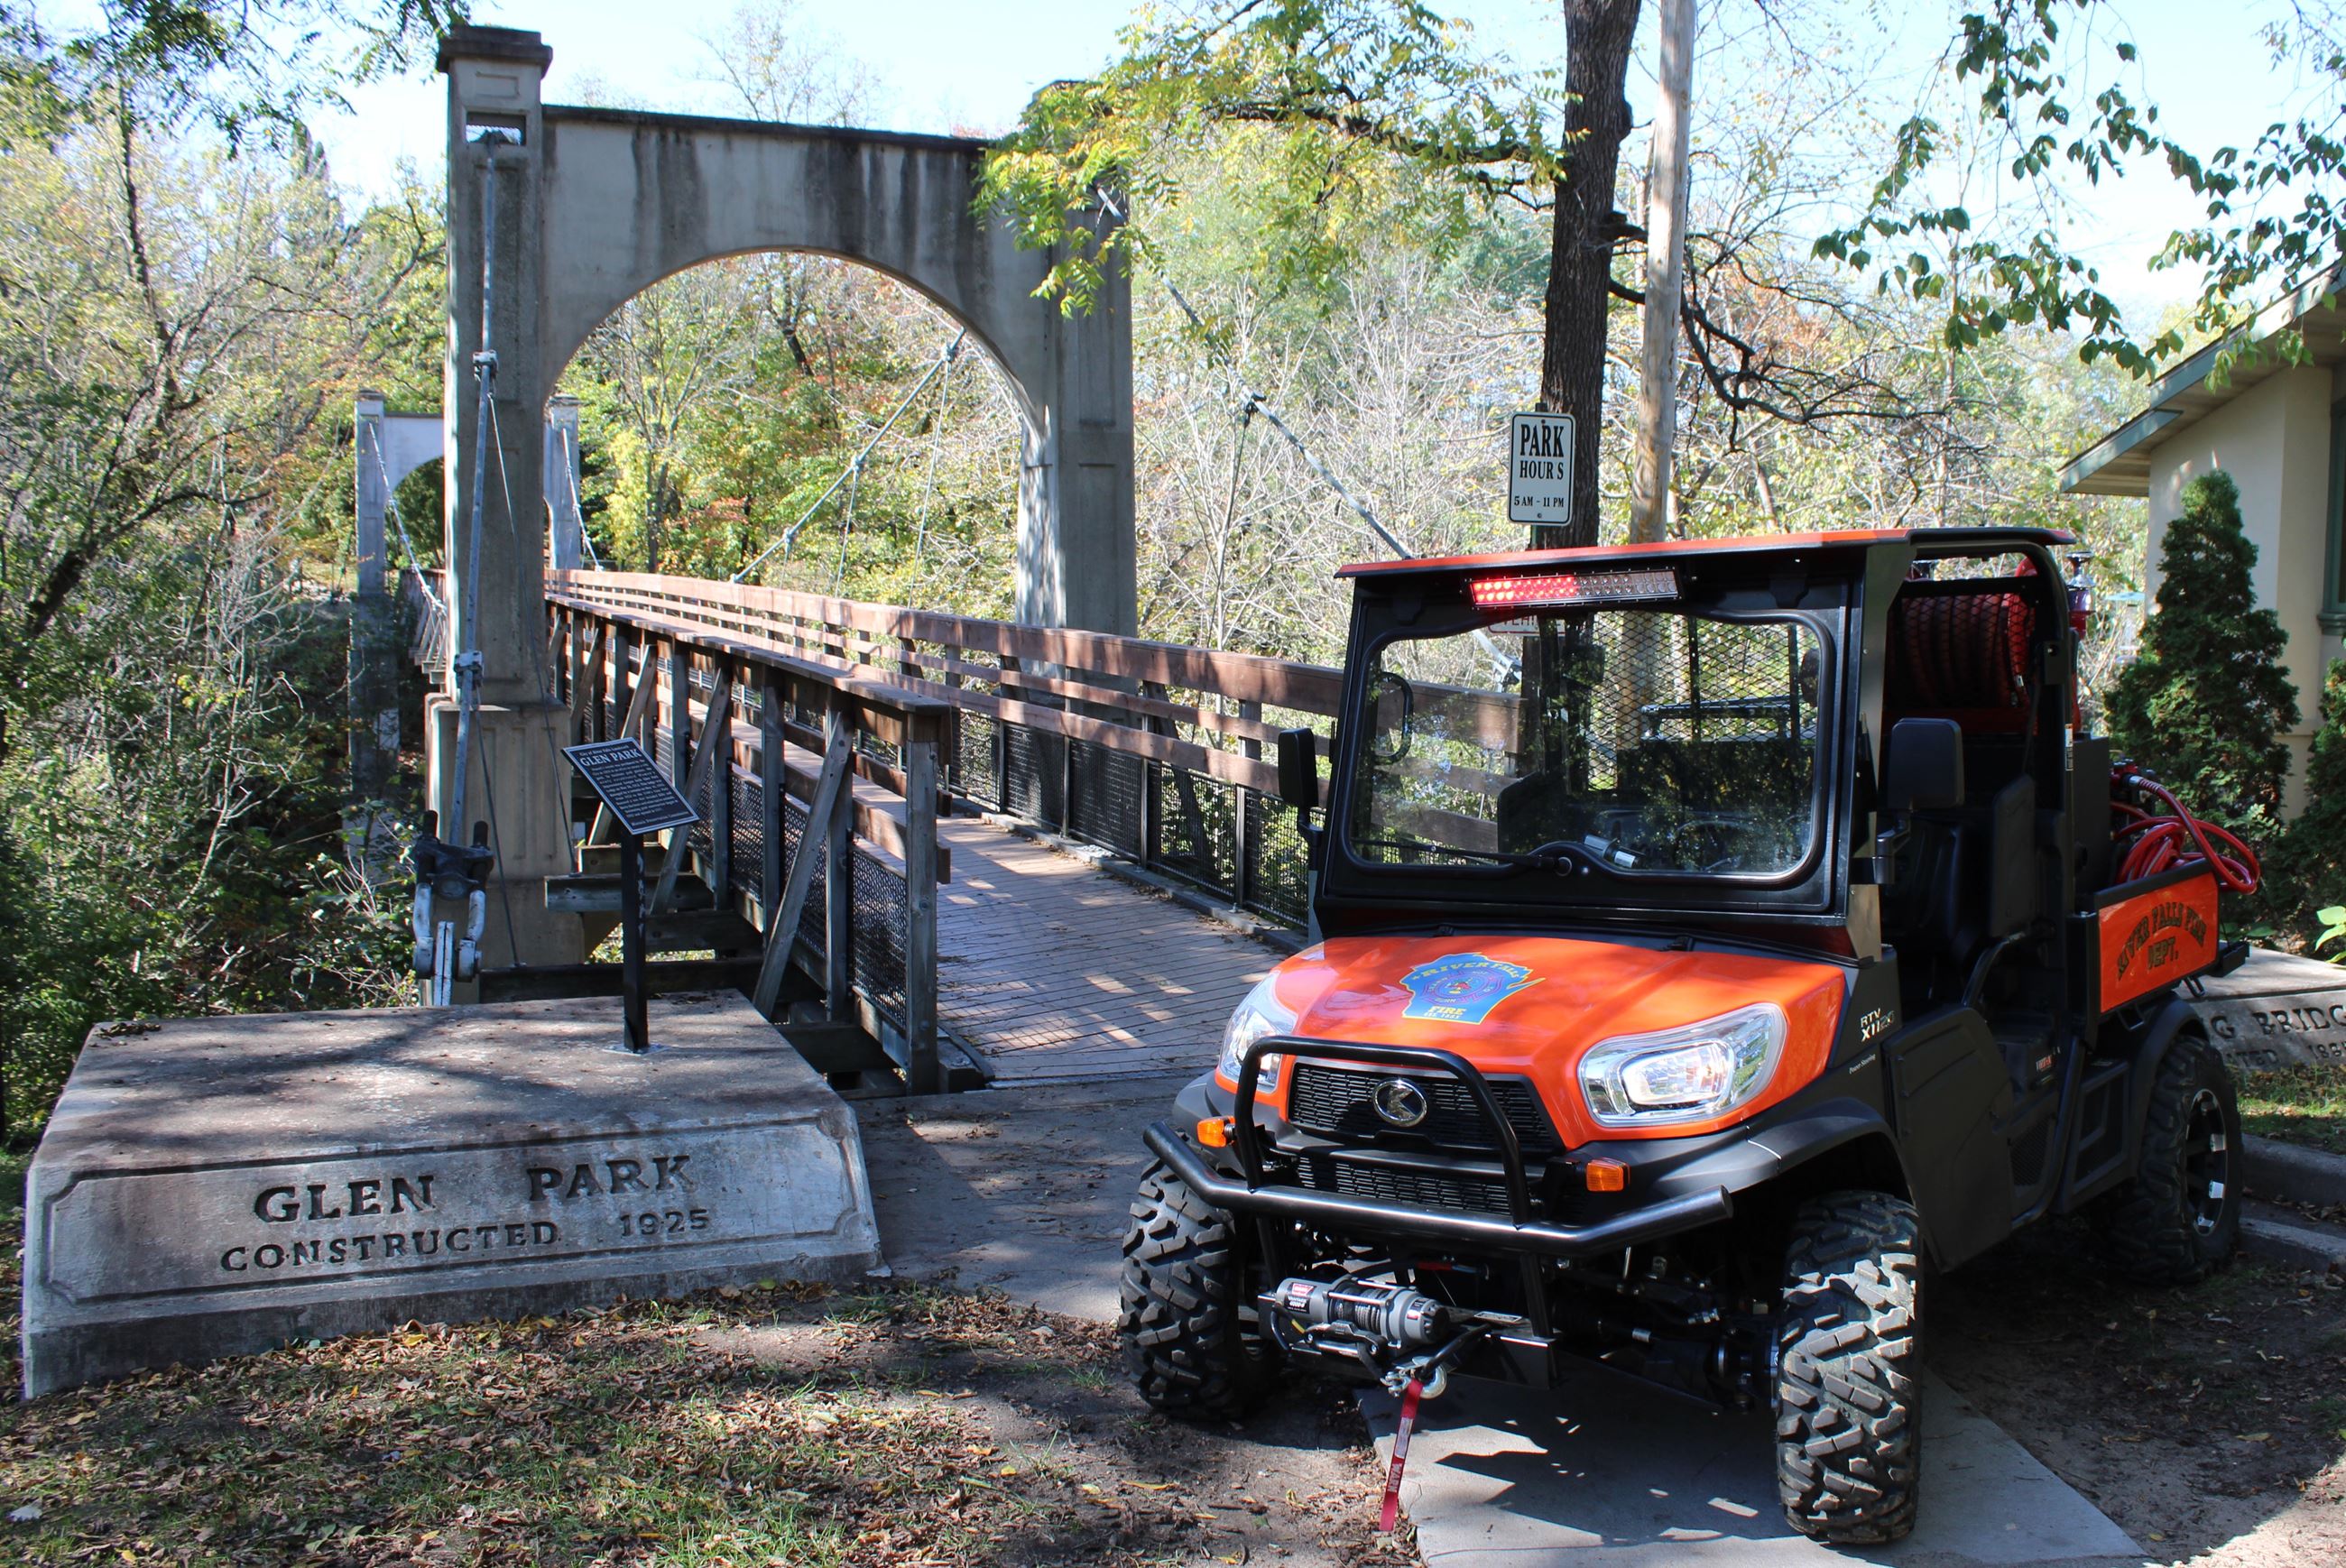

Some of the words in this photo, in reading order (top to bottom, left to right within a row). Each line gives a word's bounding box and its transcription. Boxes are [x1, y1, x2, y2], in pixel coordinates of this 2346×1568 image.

[1519, 423, 1565, 458] PARK
[1519, 460, 1565, 480] HOURS
[1521, 496, 1533, 506] AM
[1543, 497, 1550, 507] 11
[1553, 497, 1565, 507] PM
[579, 753, 611, 766] GLEN
[610, 749, 642, 761] PARK
[2117, 917, 2150, 982] RIVER
[2152, 902, 2184, 935] FALLS
[2148, 936, 2179, 971] DEPT.
[1421, 962, 1488, 977] RIVER
[1491, 962, 1519, 979] FALLS
[1427, 1005, 1466, 1015] FIRE
[1861, 1008, 1880, 1028] RTV
[254, 1175, 436, 1223] GLEN
[527, 1155, 697, 1203] PARK
[221, 1221, 559, 1272] CONSTRUCTED
[621, 1208, 710, 1237] 1925
